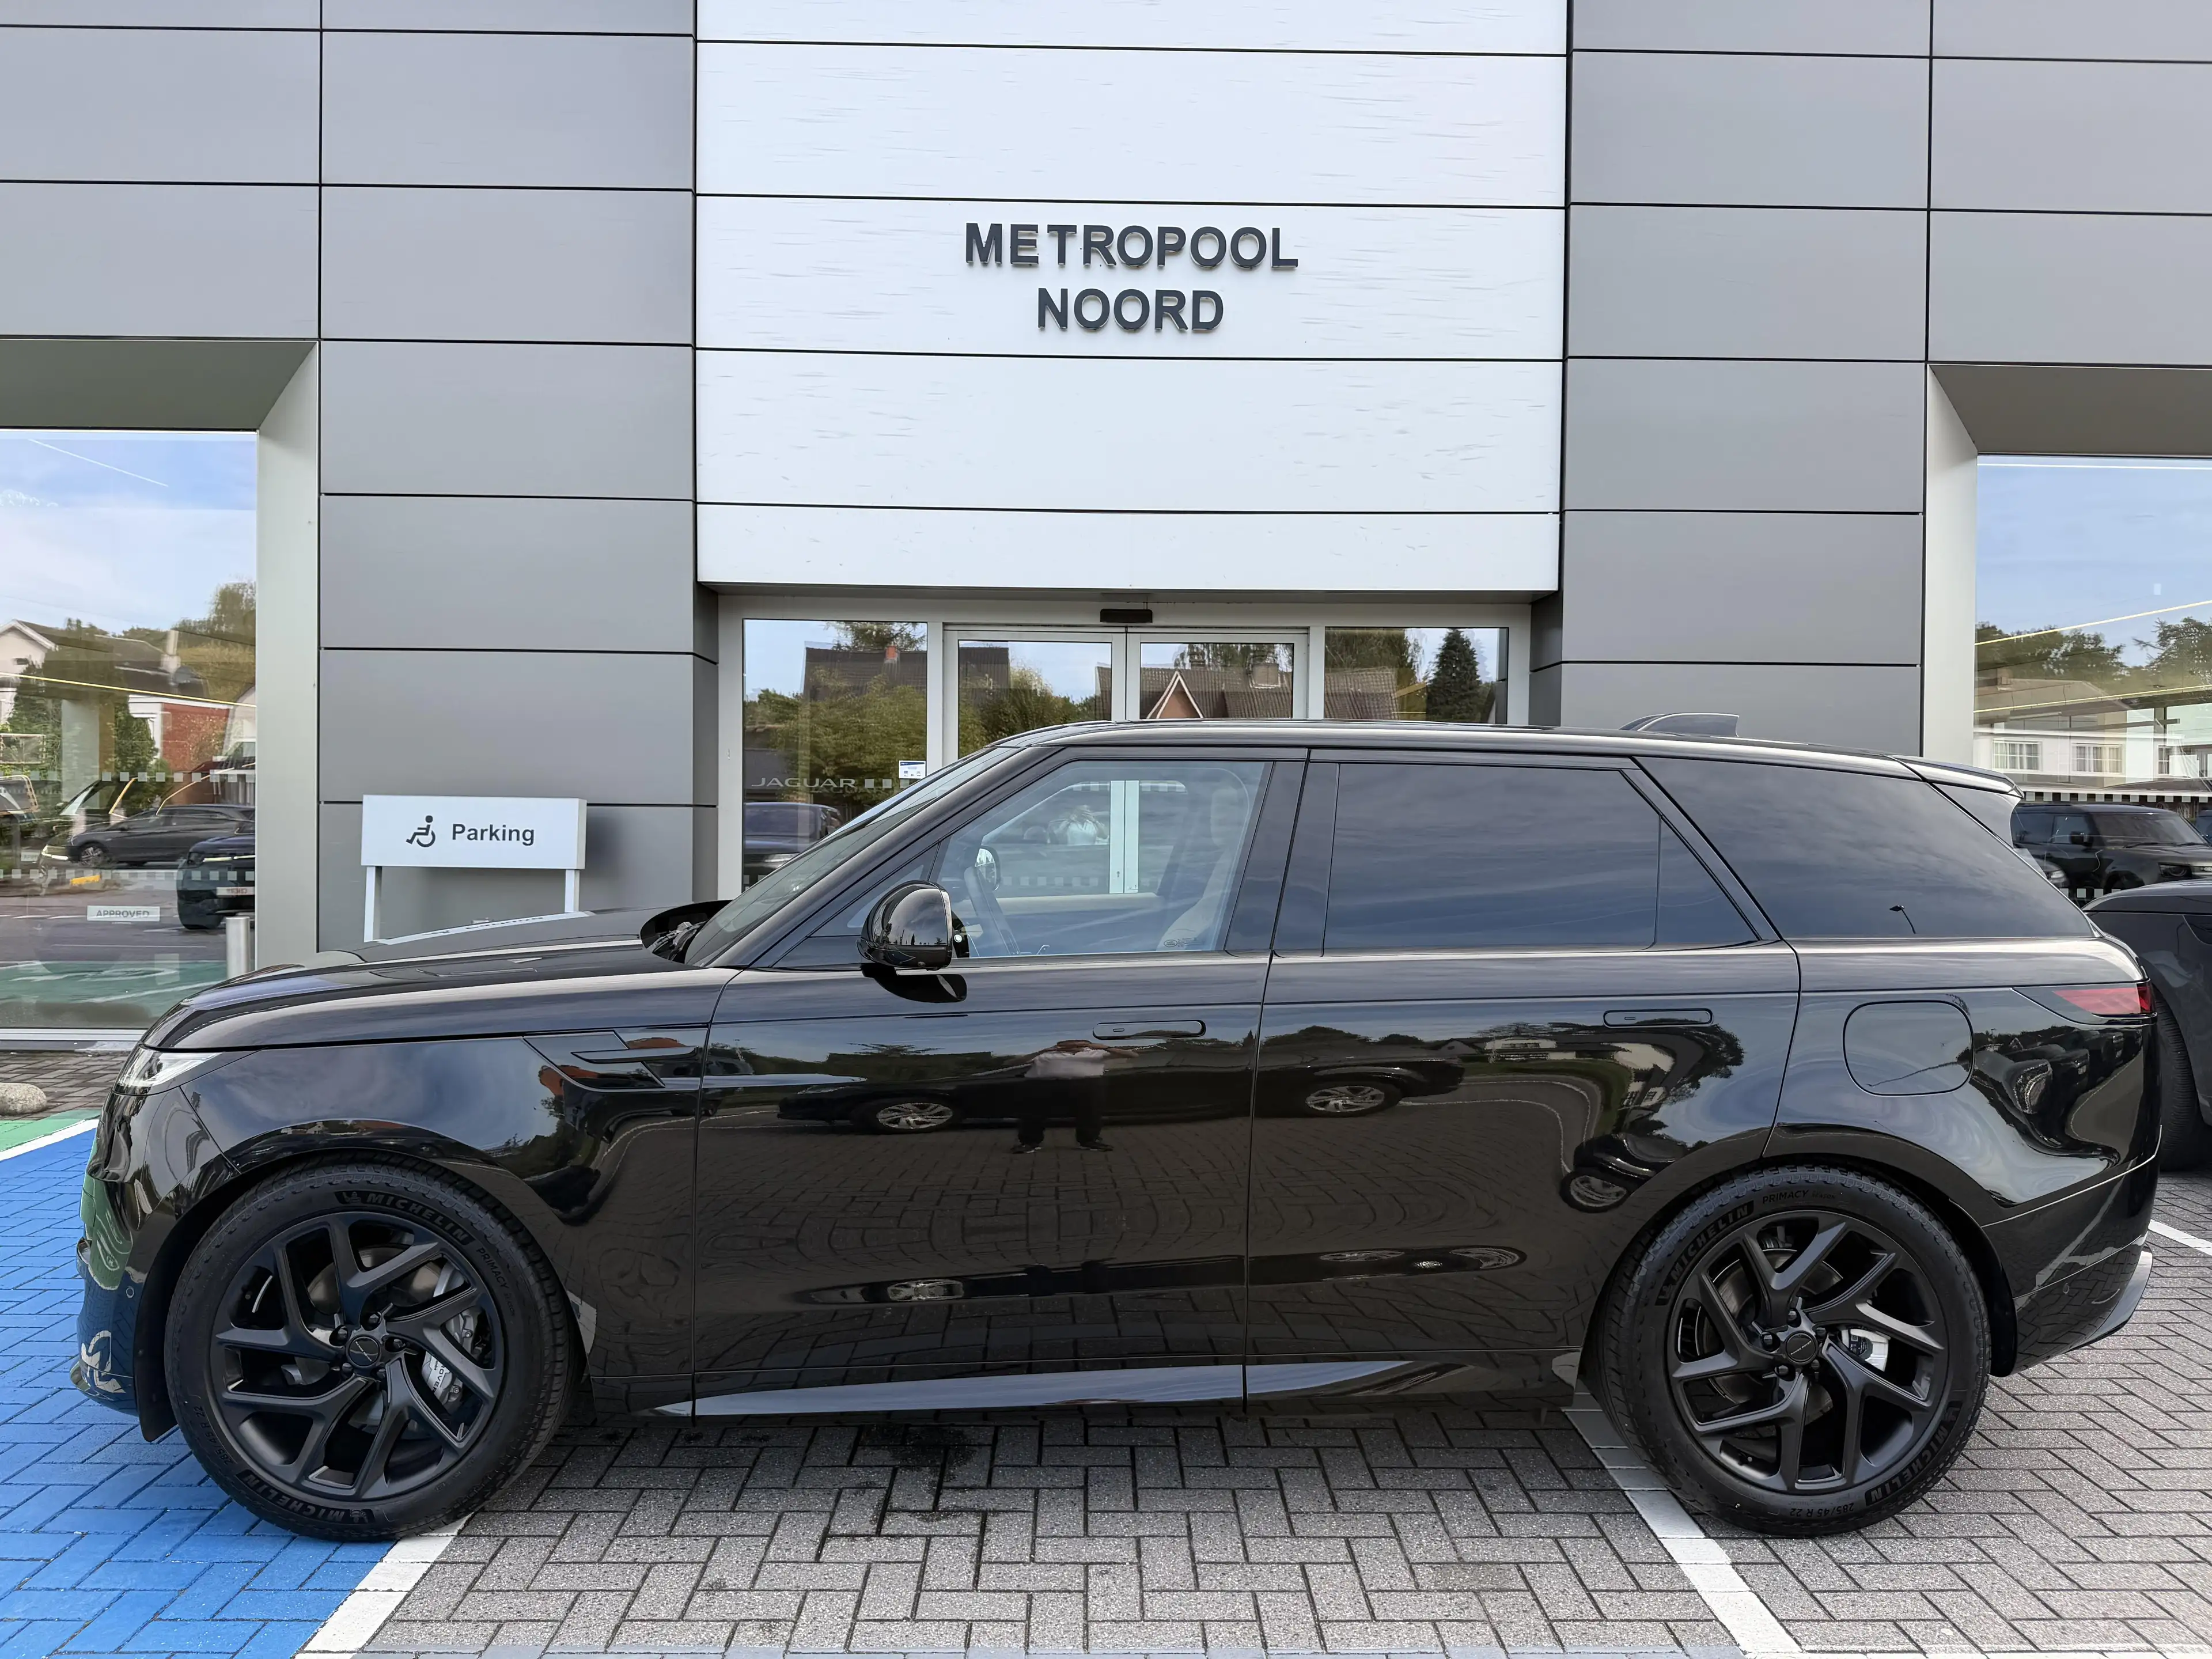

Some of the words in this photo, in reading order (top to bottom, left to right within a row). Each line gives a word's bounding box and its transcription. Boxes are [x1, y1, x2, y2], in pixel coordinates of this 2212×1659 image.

[965, 222, 1298, 268] METROPOOL
[1037, 288, 1224, 331] NOORD
[751, 778, 856, 788] JAGUAR
[452, 823, 535, 846] Parking
[96, 910, 150, 918] APPROVED
[1762, 1190, 1809, 1204] PRIMACY
[366, 1192, 469, 1239] MICHELIN
[1670, 1204, 1749, 1280] MICHELIN
[476, 1248, 509, 1289] PRIMACY
[193, 1406, 205, 1417] 22
[1870, 1425, 1948, 1503] MICHELIN
[243, 1474, 346, 1521] MICHELIN
[1790, 1508, 1803, 1517] 22
[1806, 1509, 1813, 1517] R
[1817, 1502, 1854, 1517] 285/45
